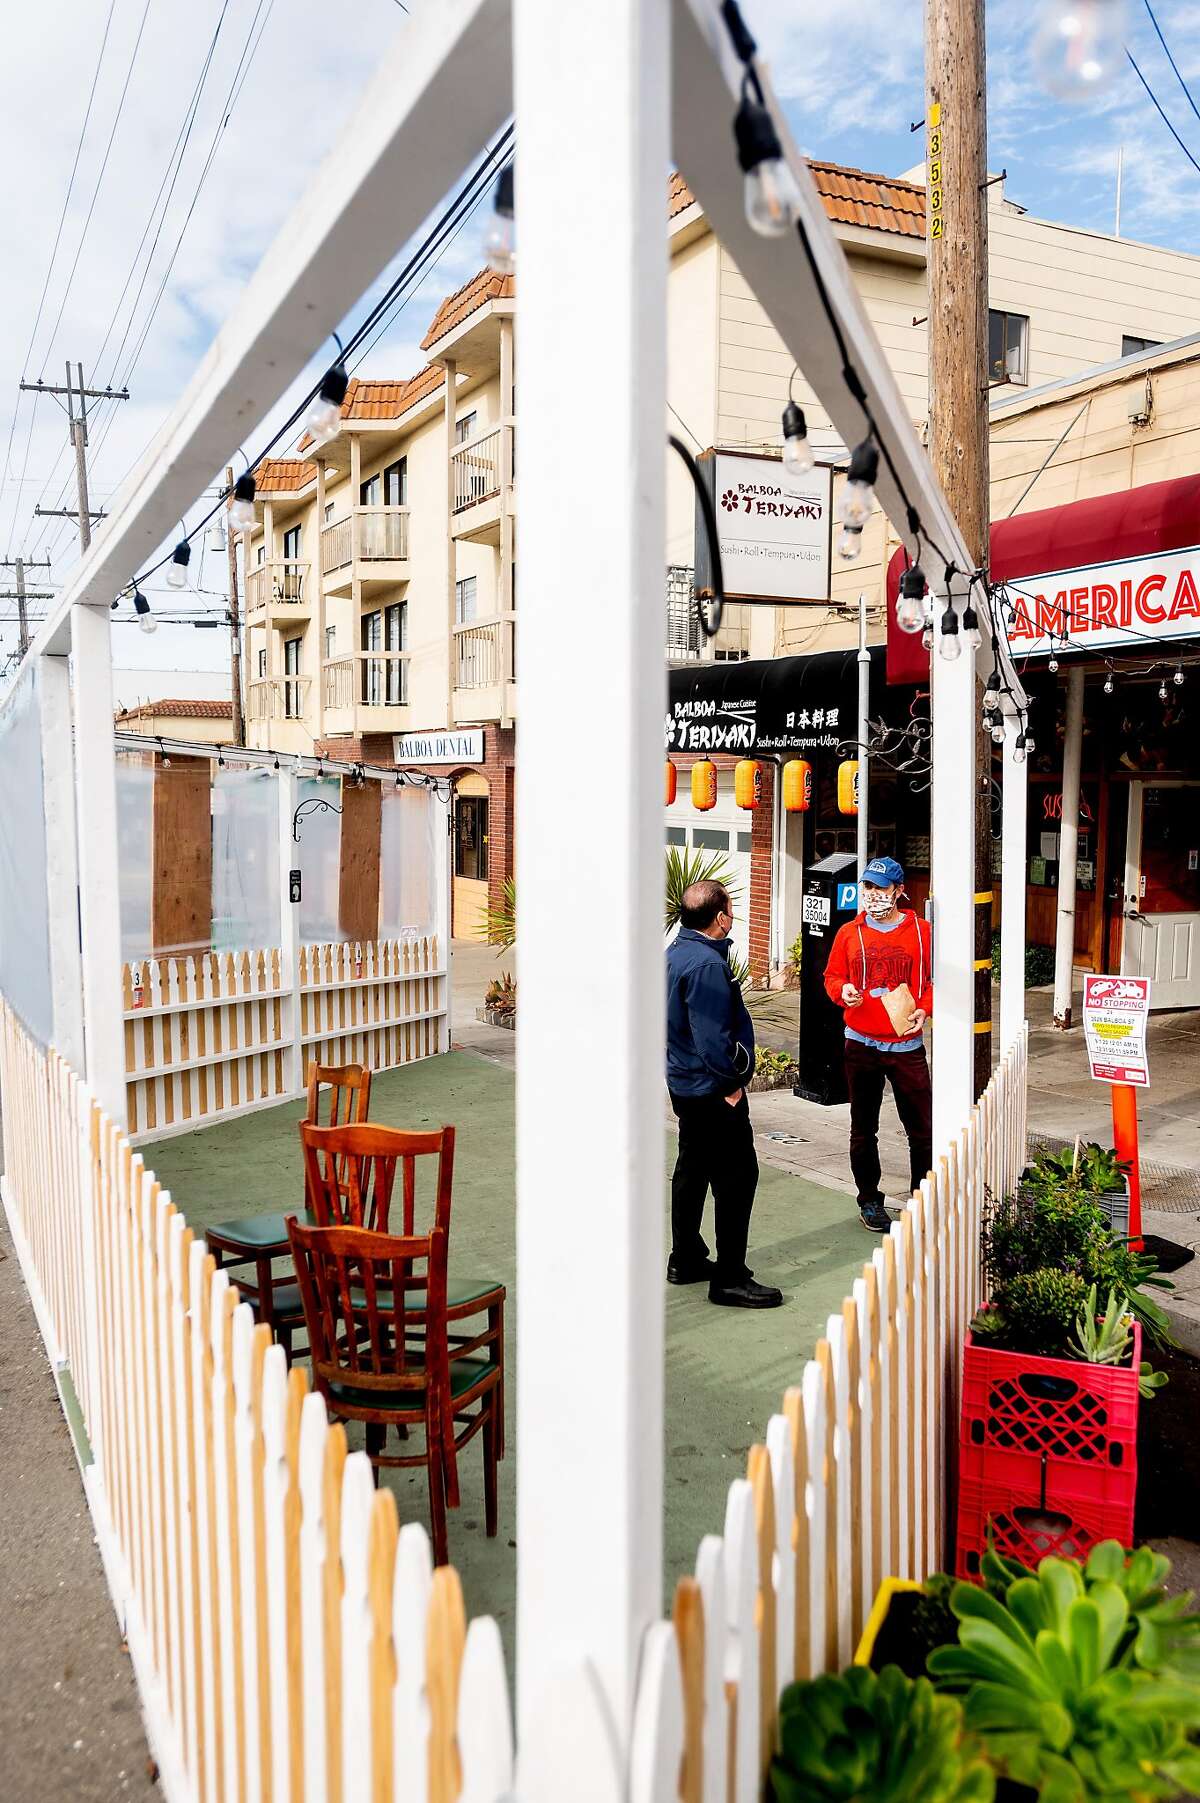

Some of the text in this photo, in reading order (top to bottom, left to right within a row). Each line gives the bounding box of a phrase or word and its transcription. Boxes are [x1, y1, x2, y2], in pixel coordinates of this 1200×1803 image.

[737, 483, 782, 496] BALBOA
[742, 496, 822, 520] TERIYAKI
[720, 545, 821, 561] Sushi Roll Tempura Udon
[674, 699, 757, 719] BALBOA Japanese Cuisine
[786, 708, 839, 730] 日本料理
[677, 718, 757, 749] TERIYAKI
[756, 733, 840, 750] Sushi Roll Tempura Udon
[398, 737, 475, 758] BALBOA DENTAL
[806, 897, 823, 910] 321
[805, 909, 828, 923] 35004
[135, 972, 140, 986] 3
[1088, 998, 1144, 1009] NO STOPPING
[1103, 1017, 1127, 1025] BALBOA
